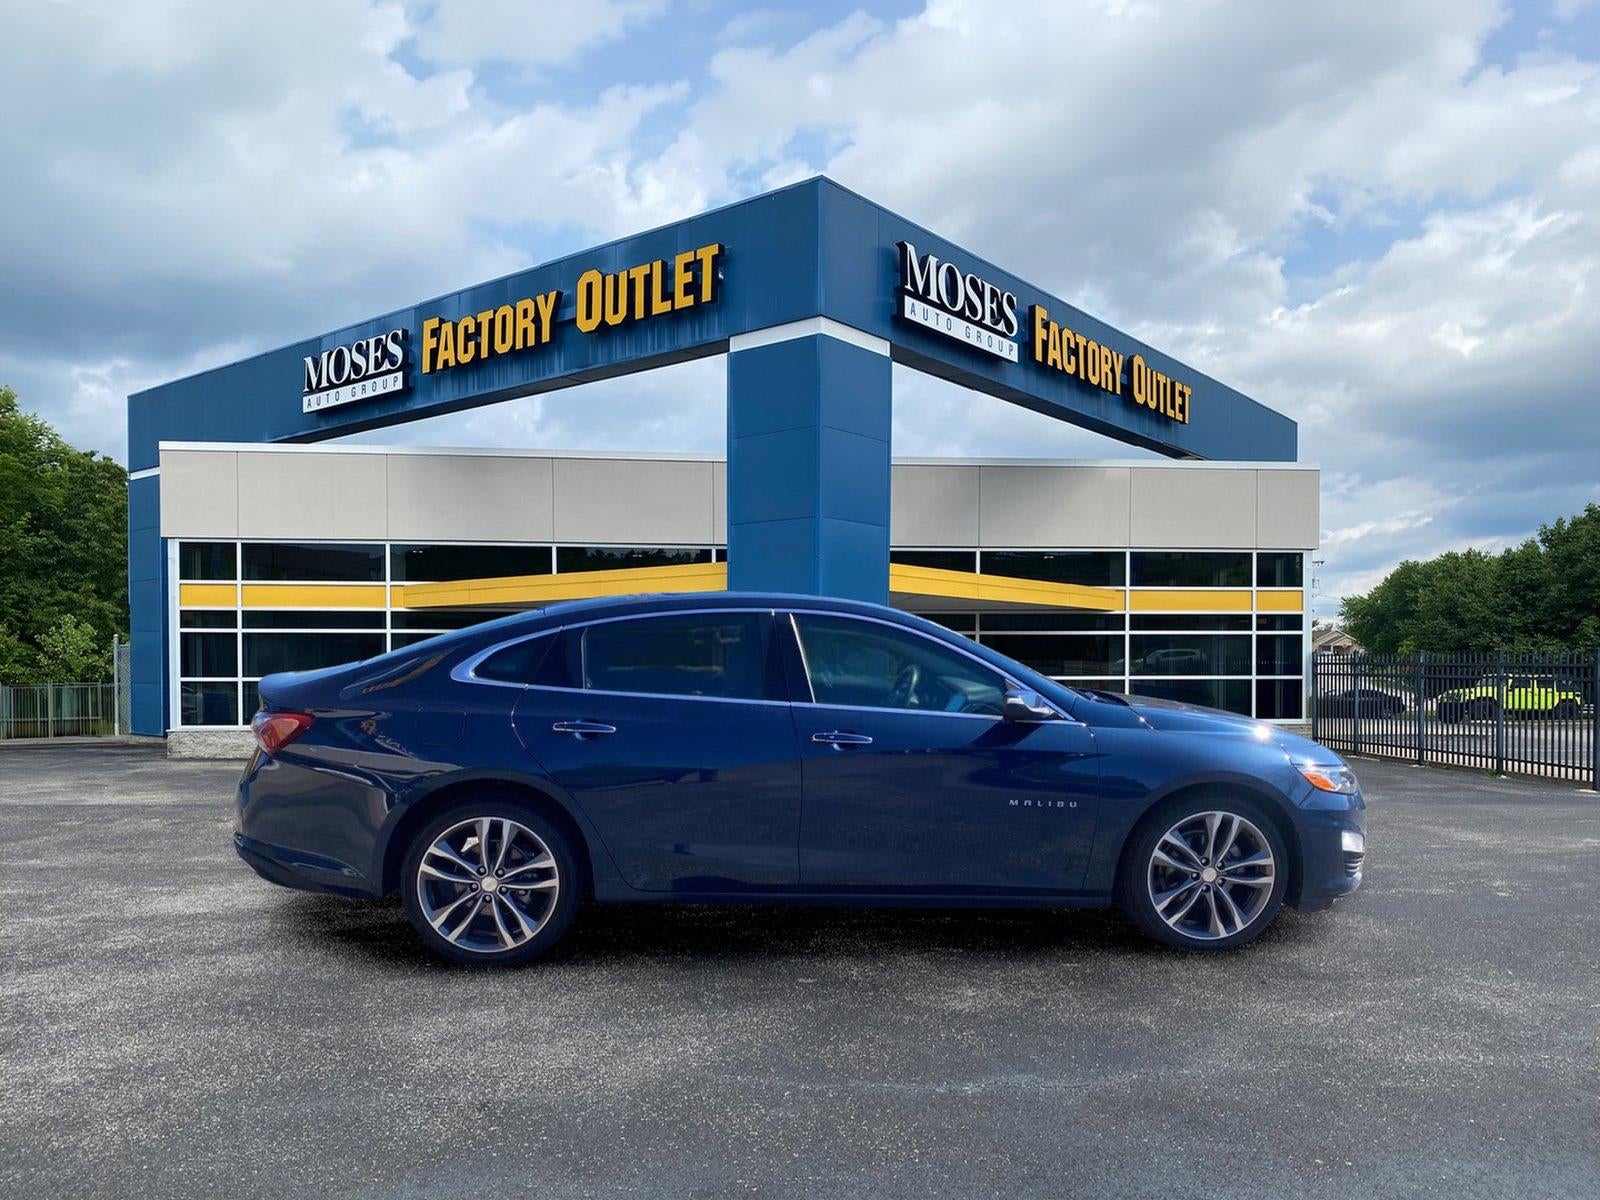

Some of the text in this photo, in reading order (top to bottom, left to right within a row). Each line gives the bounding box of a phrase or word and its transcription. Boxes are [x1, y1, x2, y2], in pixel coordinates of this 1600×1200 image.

[421, 243, 719, 374] FACTORY OUTLET
[904, 241, 1018, 337] MOSES
[910, 302, 1014, 353] AUTO GROUP
[302, 328, 403, 392] MOSES
[1035, 304, 1192, 424] FACTORY OUTLET
[307, 376, 400, 409] AUTO GROUP
[1009, 799, 1077, 808] MALIBU
